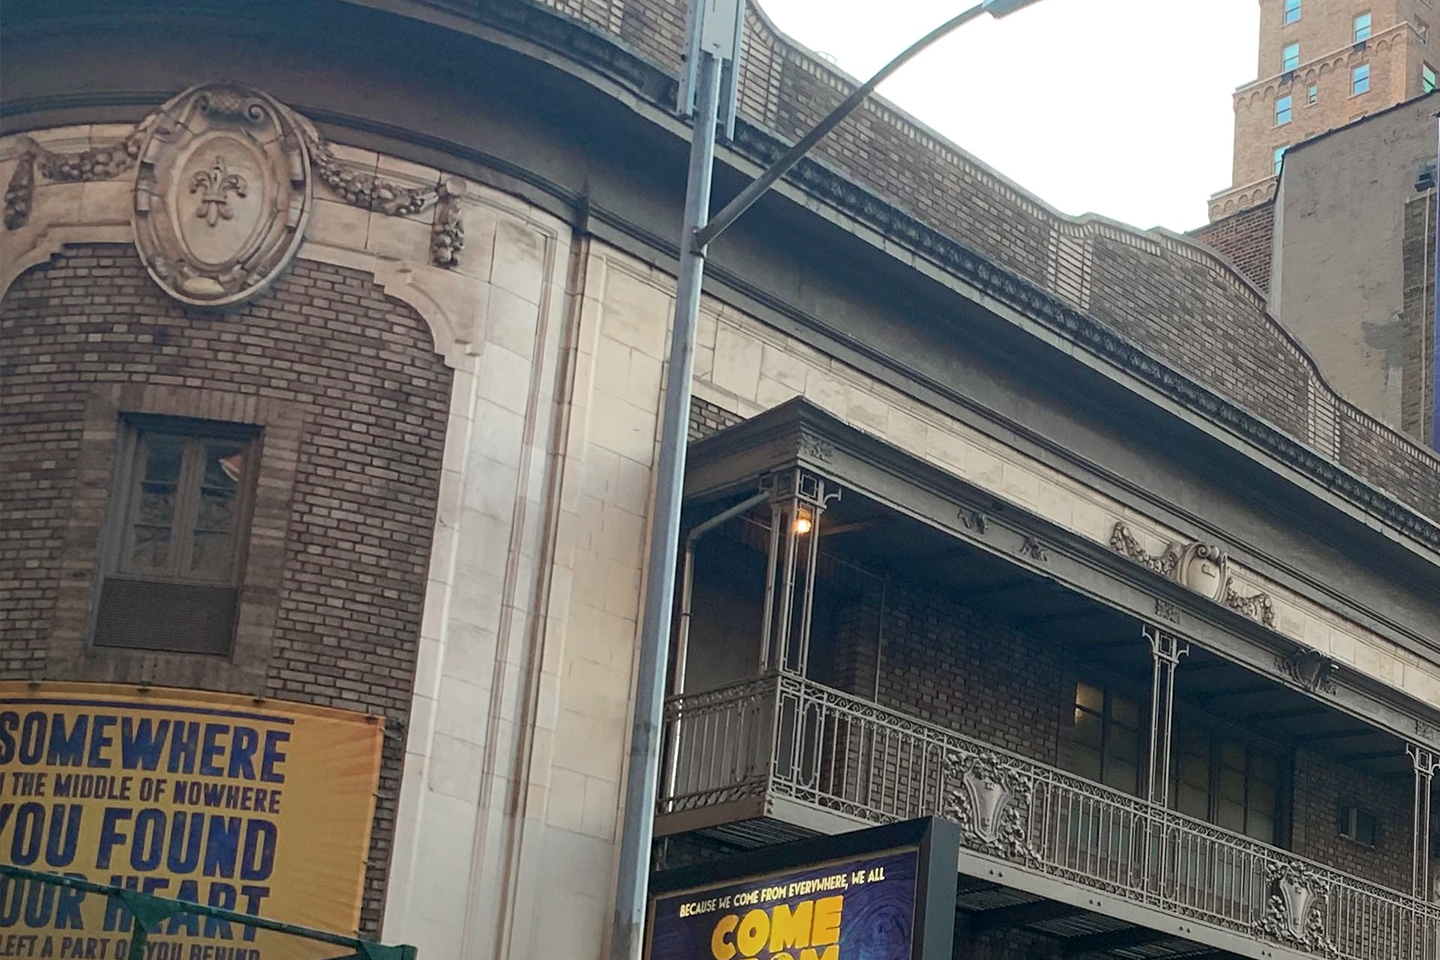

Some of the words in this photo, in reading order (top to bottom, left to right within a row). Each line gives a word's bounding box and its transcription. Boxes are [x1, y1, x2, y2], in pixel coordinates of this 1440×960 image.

[0, 710, 291, 784] SOMEWHERE
[12, 772, 47, 797] THE
[53, 774, 131, 800] MIDDLE
[139, 777, 167, 801] OF
[173, 780, 283, 814] NOWHERE
[96, 807, 278, 881] FOUND
[102, 875, 271, 942] HEART
[679, 897, 717, 918] BECAUSE
[718, 895, 731, 909] WE
[733, 889, 759, 907] COME
[760, 884, 787, 902] FROM
[788, 873, 849, 898] EVERYWHERE,
[851, 871, 866, 885] WE
[868, 867, 885, 882] ALL
[41, 936, 53, 958] A
[60, 937, 109, 960] PART
